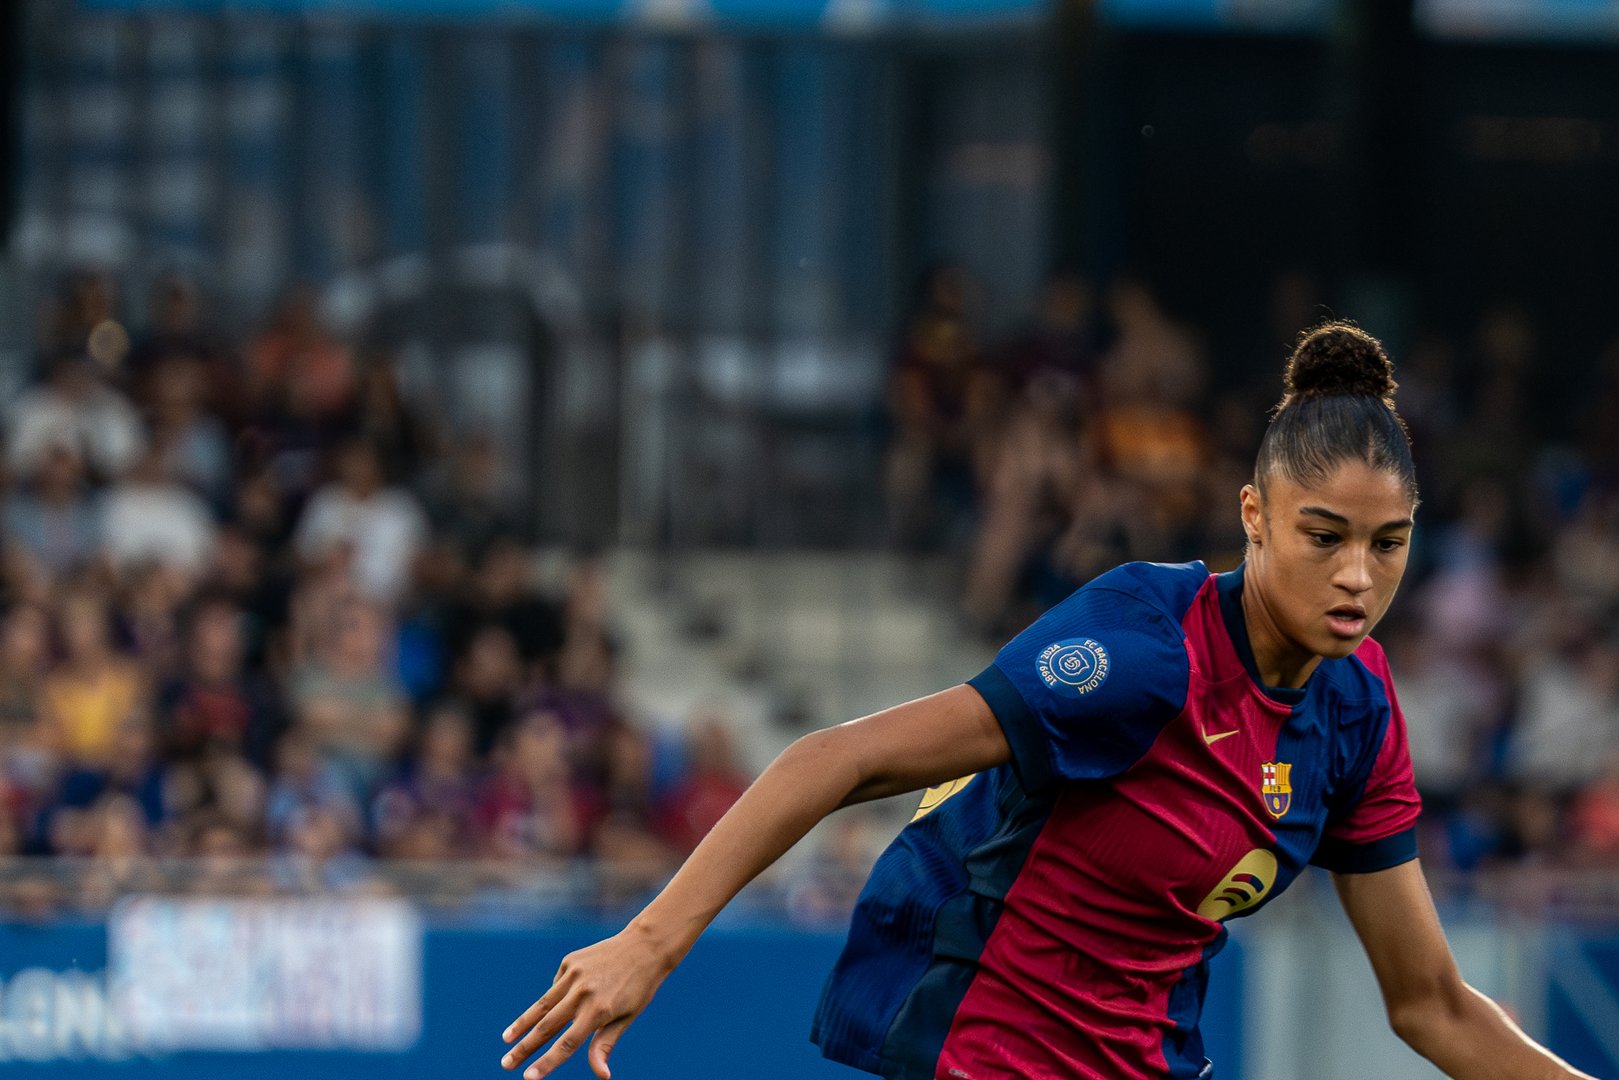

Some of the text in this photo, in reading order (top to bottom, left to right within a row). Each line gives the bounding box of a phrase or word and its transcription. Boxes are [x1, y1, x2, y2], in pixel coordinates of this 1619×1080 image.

[1041, 643, 1061, 659] 2024
[1039, 665, 1058, 686] 1899
[1077, 639, 1108, 694] FC BARCELONA
